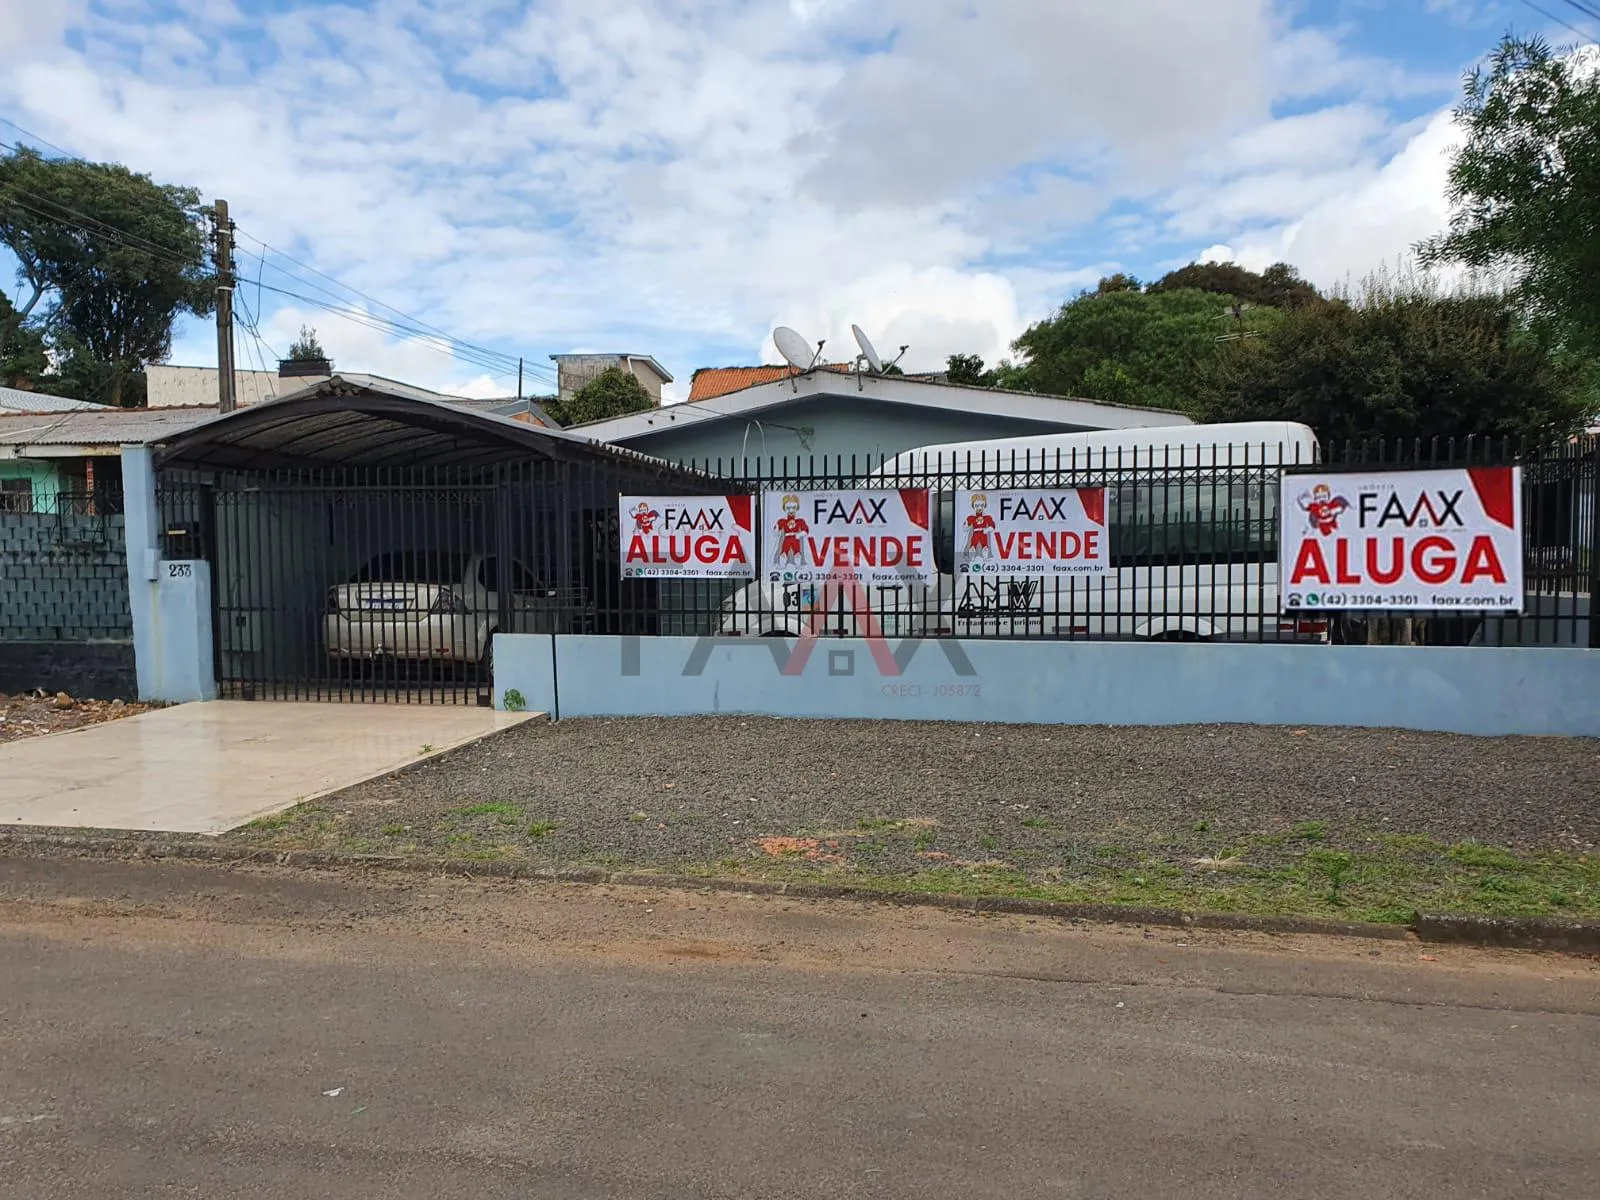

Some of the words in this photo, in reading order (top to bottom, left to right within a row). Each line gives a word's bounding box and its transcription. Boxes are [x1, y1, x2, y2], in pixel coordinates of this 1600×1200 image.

[665, 507, 724, 530] FAAX
[813, 497, 889, 525] FAAX
[1000, 496, 1067, 521] FAAX
[1358, 489, 1465, 529] FAAX
[626, 535, 746, 564] ALUGA
[807, 535, 923, 568] VENDE
[993, 531, 1100, 560] VENDE
[644, 568, 659, 577] (42)
[706, 569, 752, 577] faax.com.br
[982, 563, 999, 573] (42)
[1052, 563, 1104, 572] faax.com.br
[1290, 535, 1509, 585] ALUGA
[794, 571, 813, 582] (42)
[872, 572, 929, 581] faax.com.br
[1321, 592, 1347, 606] (42)
[1351, 594, 1418, 605] 3304-3301
[1432, 594, 1514, 606] faax.com.br
